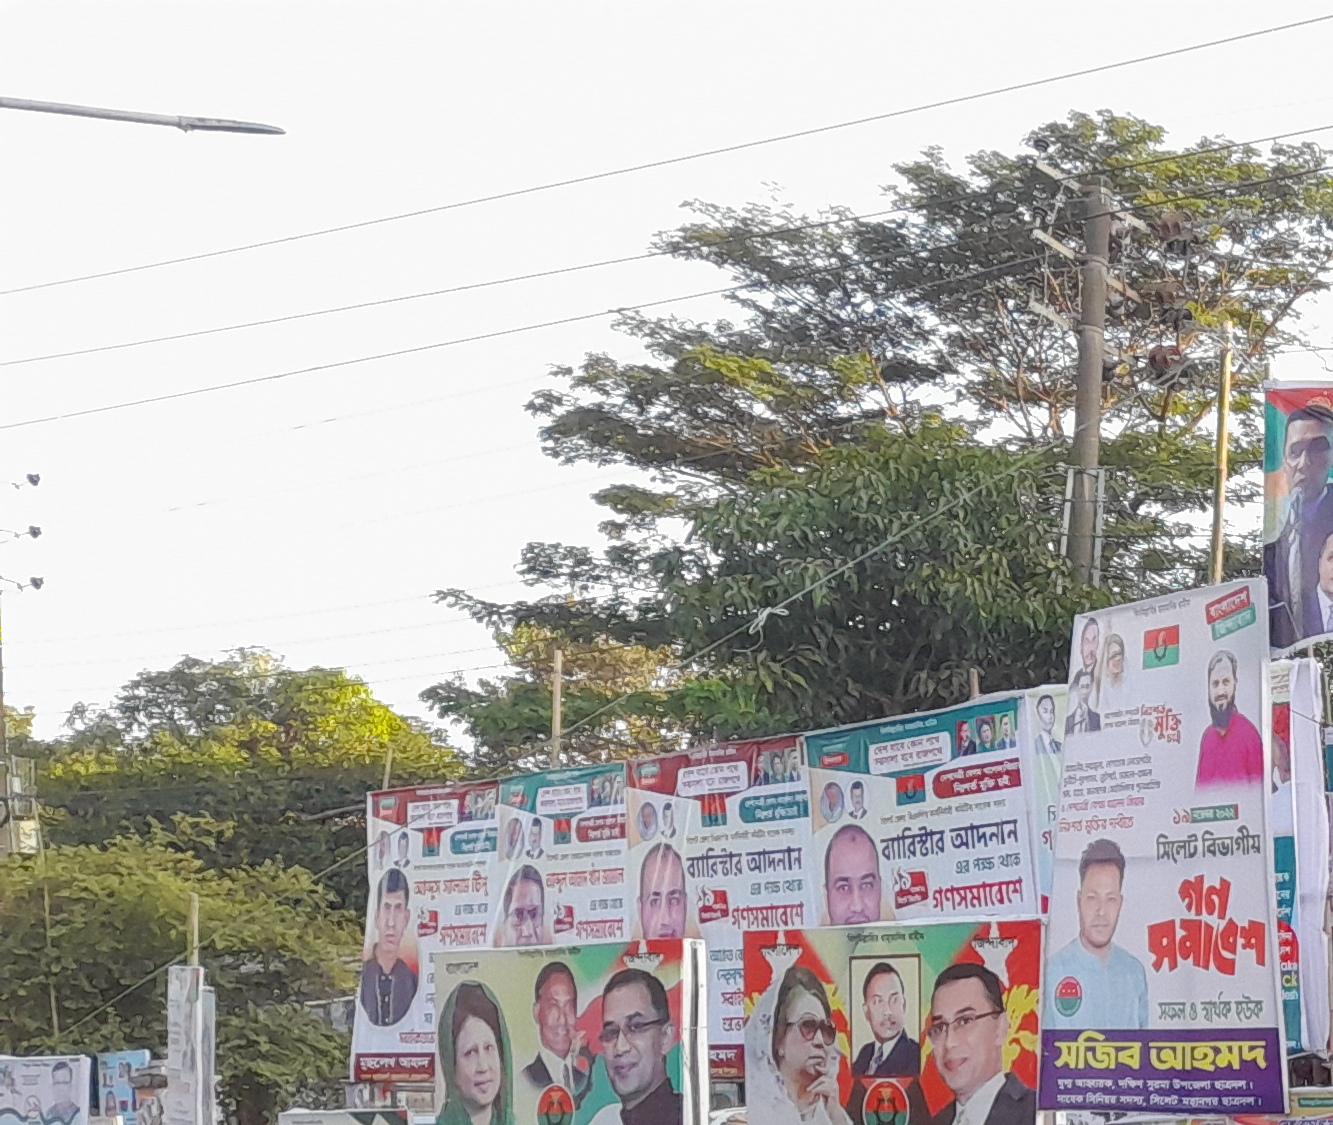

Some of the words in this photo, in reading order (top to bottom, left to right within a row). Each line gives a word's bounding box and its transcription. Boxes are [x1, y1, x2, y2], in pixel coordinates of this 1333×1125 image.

[881, 825, 944, 862] ব্যারিস্টার
[949, 819, 1019, 851] আদনান
[1156, 833, 1198, 863] সিলেট
[1202, 825, 1261, 858] বিভাগীয়
[686, 850, 743, 880] ব্যারিস্টার
[746, 846, 802, 874] আদনান
[933, 878, 1024, 911] গণসমাবেশে
[1179, 874, 1231, 922] গণ
[731, 902, 804, 929] গণসমাবেশে
[1148, 916, 1266, 976] সমাবেশ
[1158, 1002, 1186, 1020] সফল
[1189, 1002, 1198, 1020] ও
[1236, 994, 1263, 1022] হউক
[1054, 1031, 1142, 1069] সজিব
[1149, 1041, 1267, 1071] আহমদ
